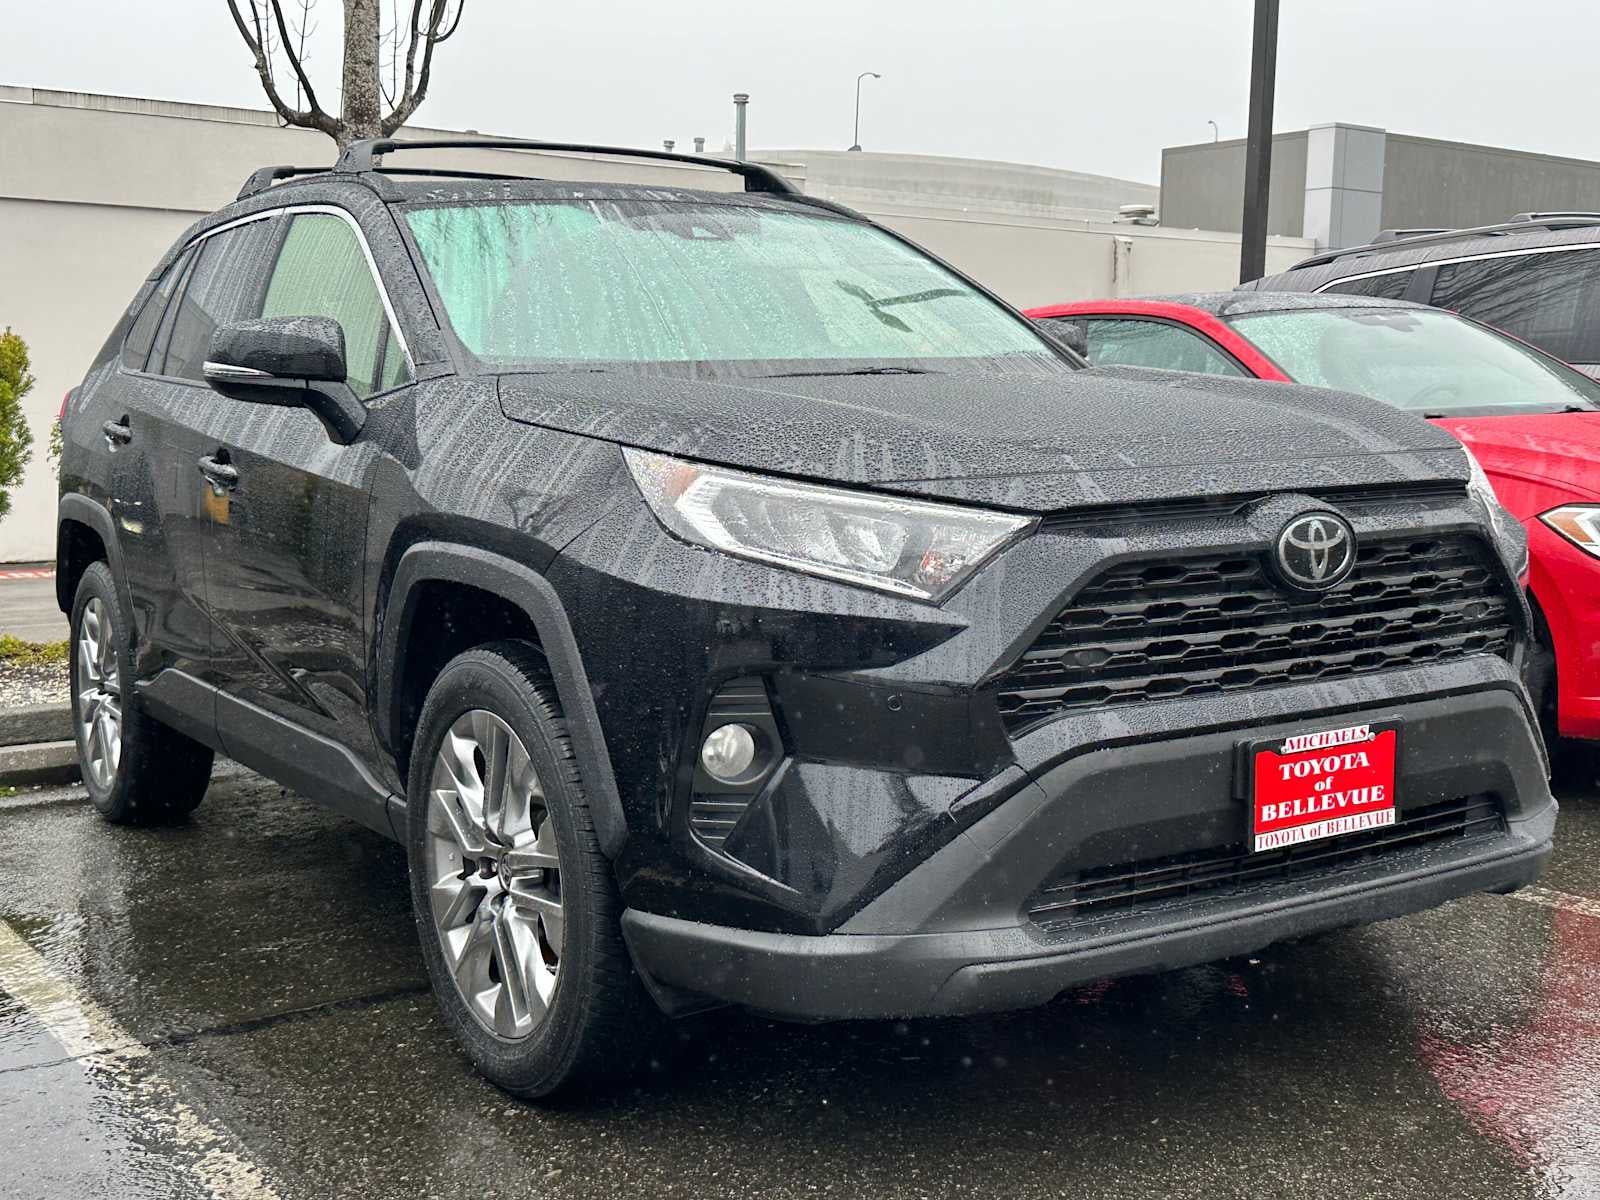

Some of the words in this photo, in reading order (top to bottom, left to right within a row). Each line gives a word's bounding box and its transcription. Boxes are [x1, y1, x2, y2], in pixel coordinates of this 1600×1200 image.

[1287, 726, 1367, 750] MICHAELS
[1279, 751, 1370, 780] TOYOTA
[1314, 776, 1334, 791] of
[1261, 785, 1385, 822] BELLEVUE
[1257, 829, 1306, 849] TOYOTA
[1309, 824, 1321, 837] of
[1327, 811, 1393, 834] BELLEVUE
